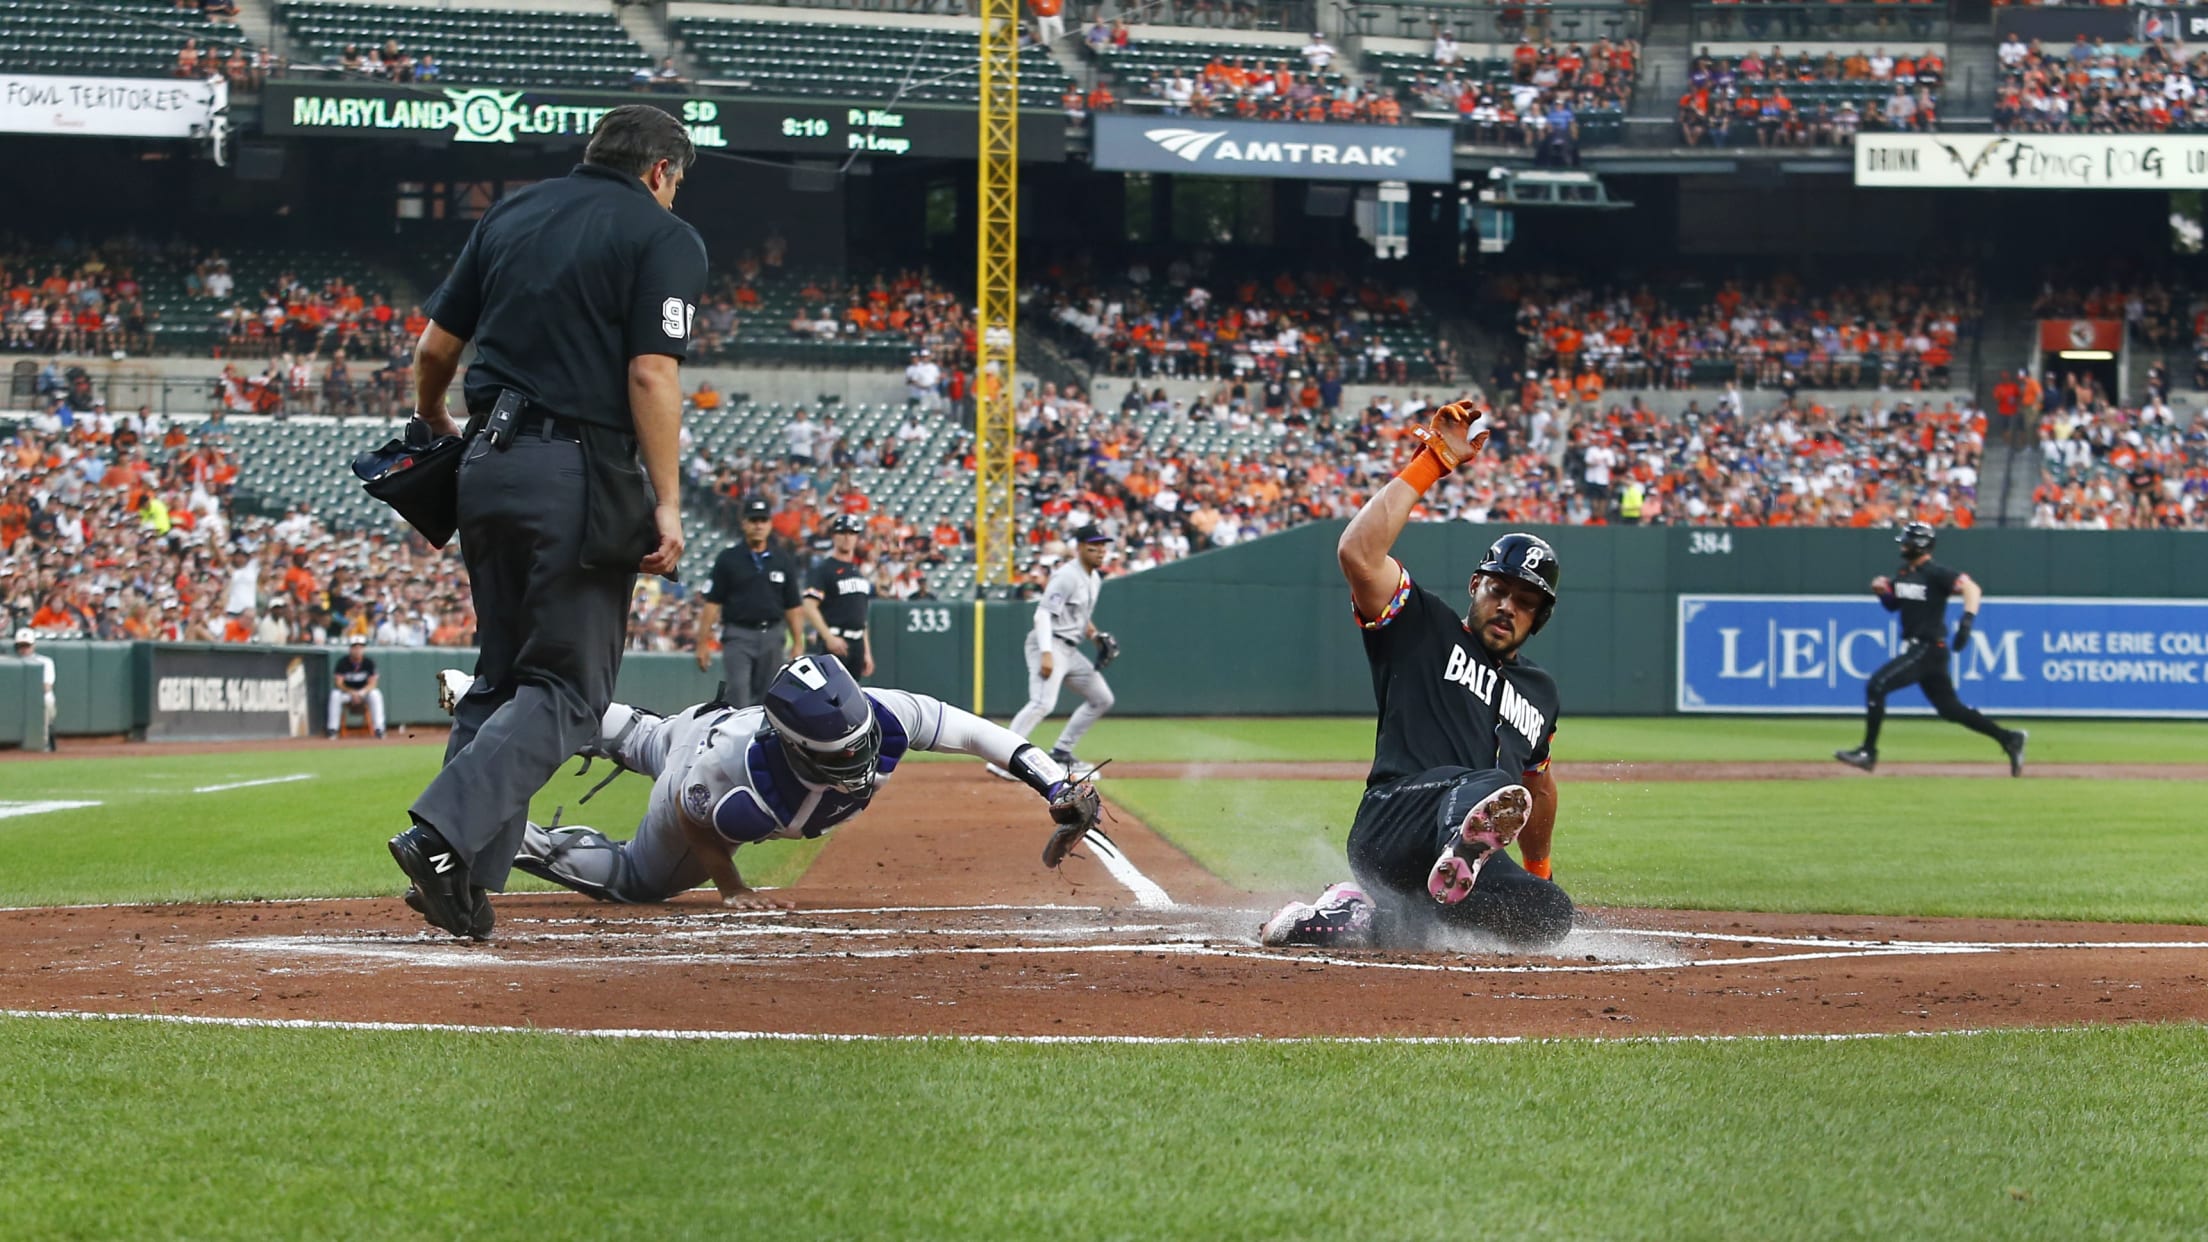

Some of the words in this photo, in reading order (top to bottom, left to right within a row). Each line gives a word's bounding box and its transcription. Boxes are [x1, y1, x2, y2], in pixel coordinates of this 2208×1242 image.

[8, 82, 63, 106] FOWL
[293, 97, 449, 129] MARYLAND
[683, 101, 717, 121] SD
[1214, 140, 1397, 166] AMTRAK
[1868, 148, 1919, 171] DRINK
[1688, 532, 1732, 553] 384
[1521, 546, 1543, 569] B
[907, 609, 951, 632] 333
[2043, 631, 2100, 653] LAKE
[2106, 632, 2155, 654] ERIE
[2043, 660, 2199, 683] OSTEOPATHIC
[429, 852, 455, 874] N
